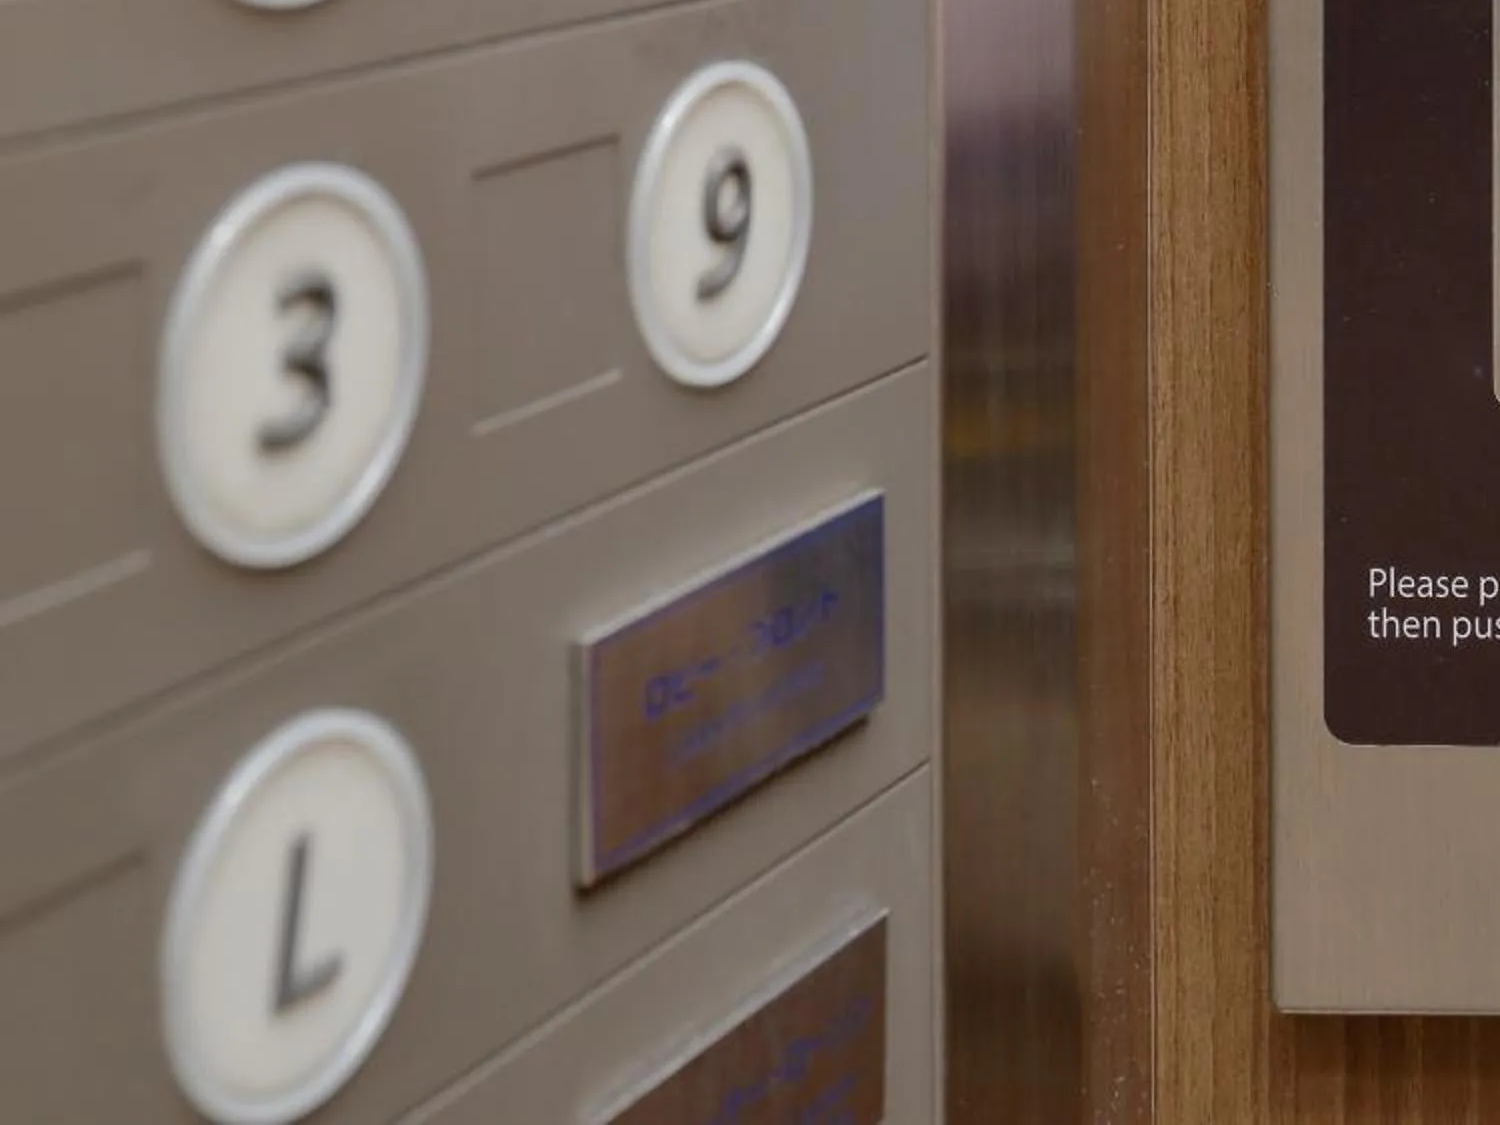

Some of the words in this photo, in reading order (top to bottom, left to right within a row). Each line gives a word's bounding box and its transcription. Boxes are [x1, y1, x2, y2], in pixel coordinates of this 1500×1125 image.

[694, 148, 754, 305] 9
[254, 267, 341, 457] 3
[1367, 607, 1441, 639] then
[1368, 567, 1469, 600] Please
[271, 833, 344, 1015] L
